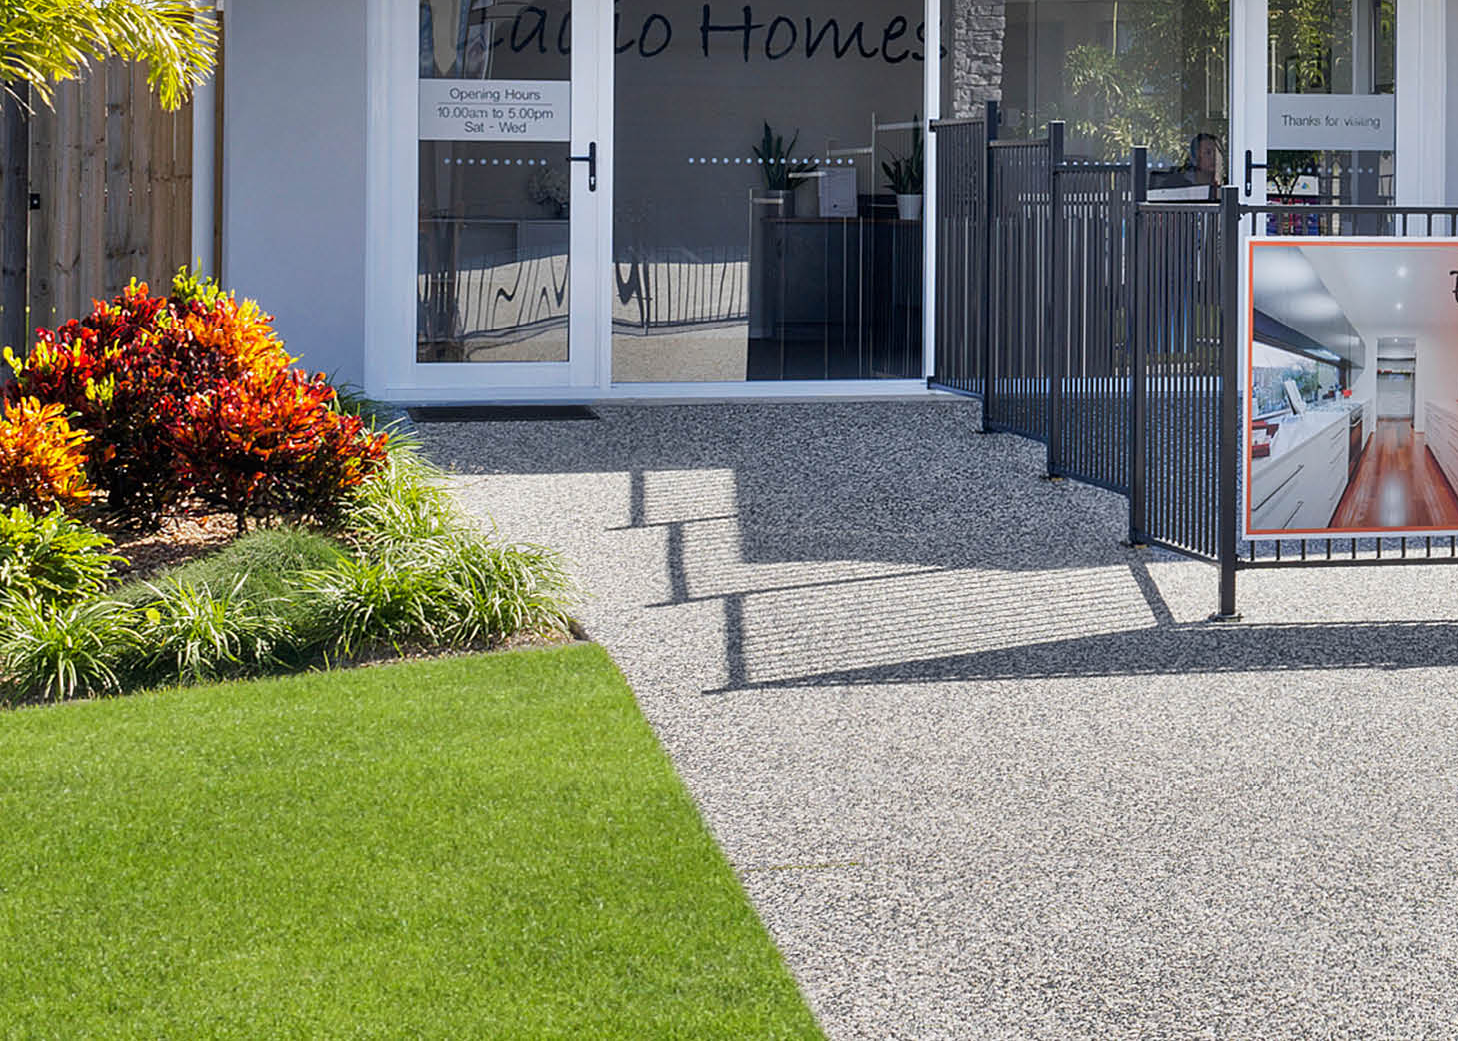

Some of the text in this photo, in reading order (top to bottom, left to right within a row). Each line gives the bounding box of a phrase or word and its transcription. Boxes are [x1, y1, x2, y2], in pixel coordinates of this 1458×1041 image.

[449, 87, 542, 102] Opening Hours
[437, 106, 554, 121] 10.00am to 5.00pm
[1281, 114, 1321, 127] Thanks
[1325, 115, 1338, 127] for
[464, 121, 485, 133] Sat
[499, 122, 527, 133] Wed
